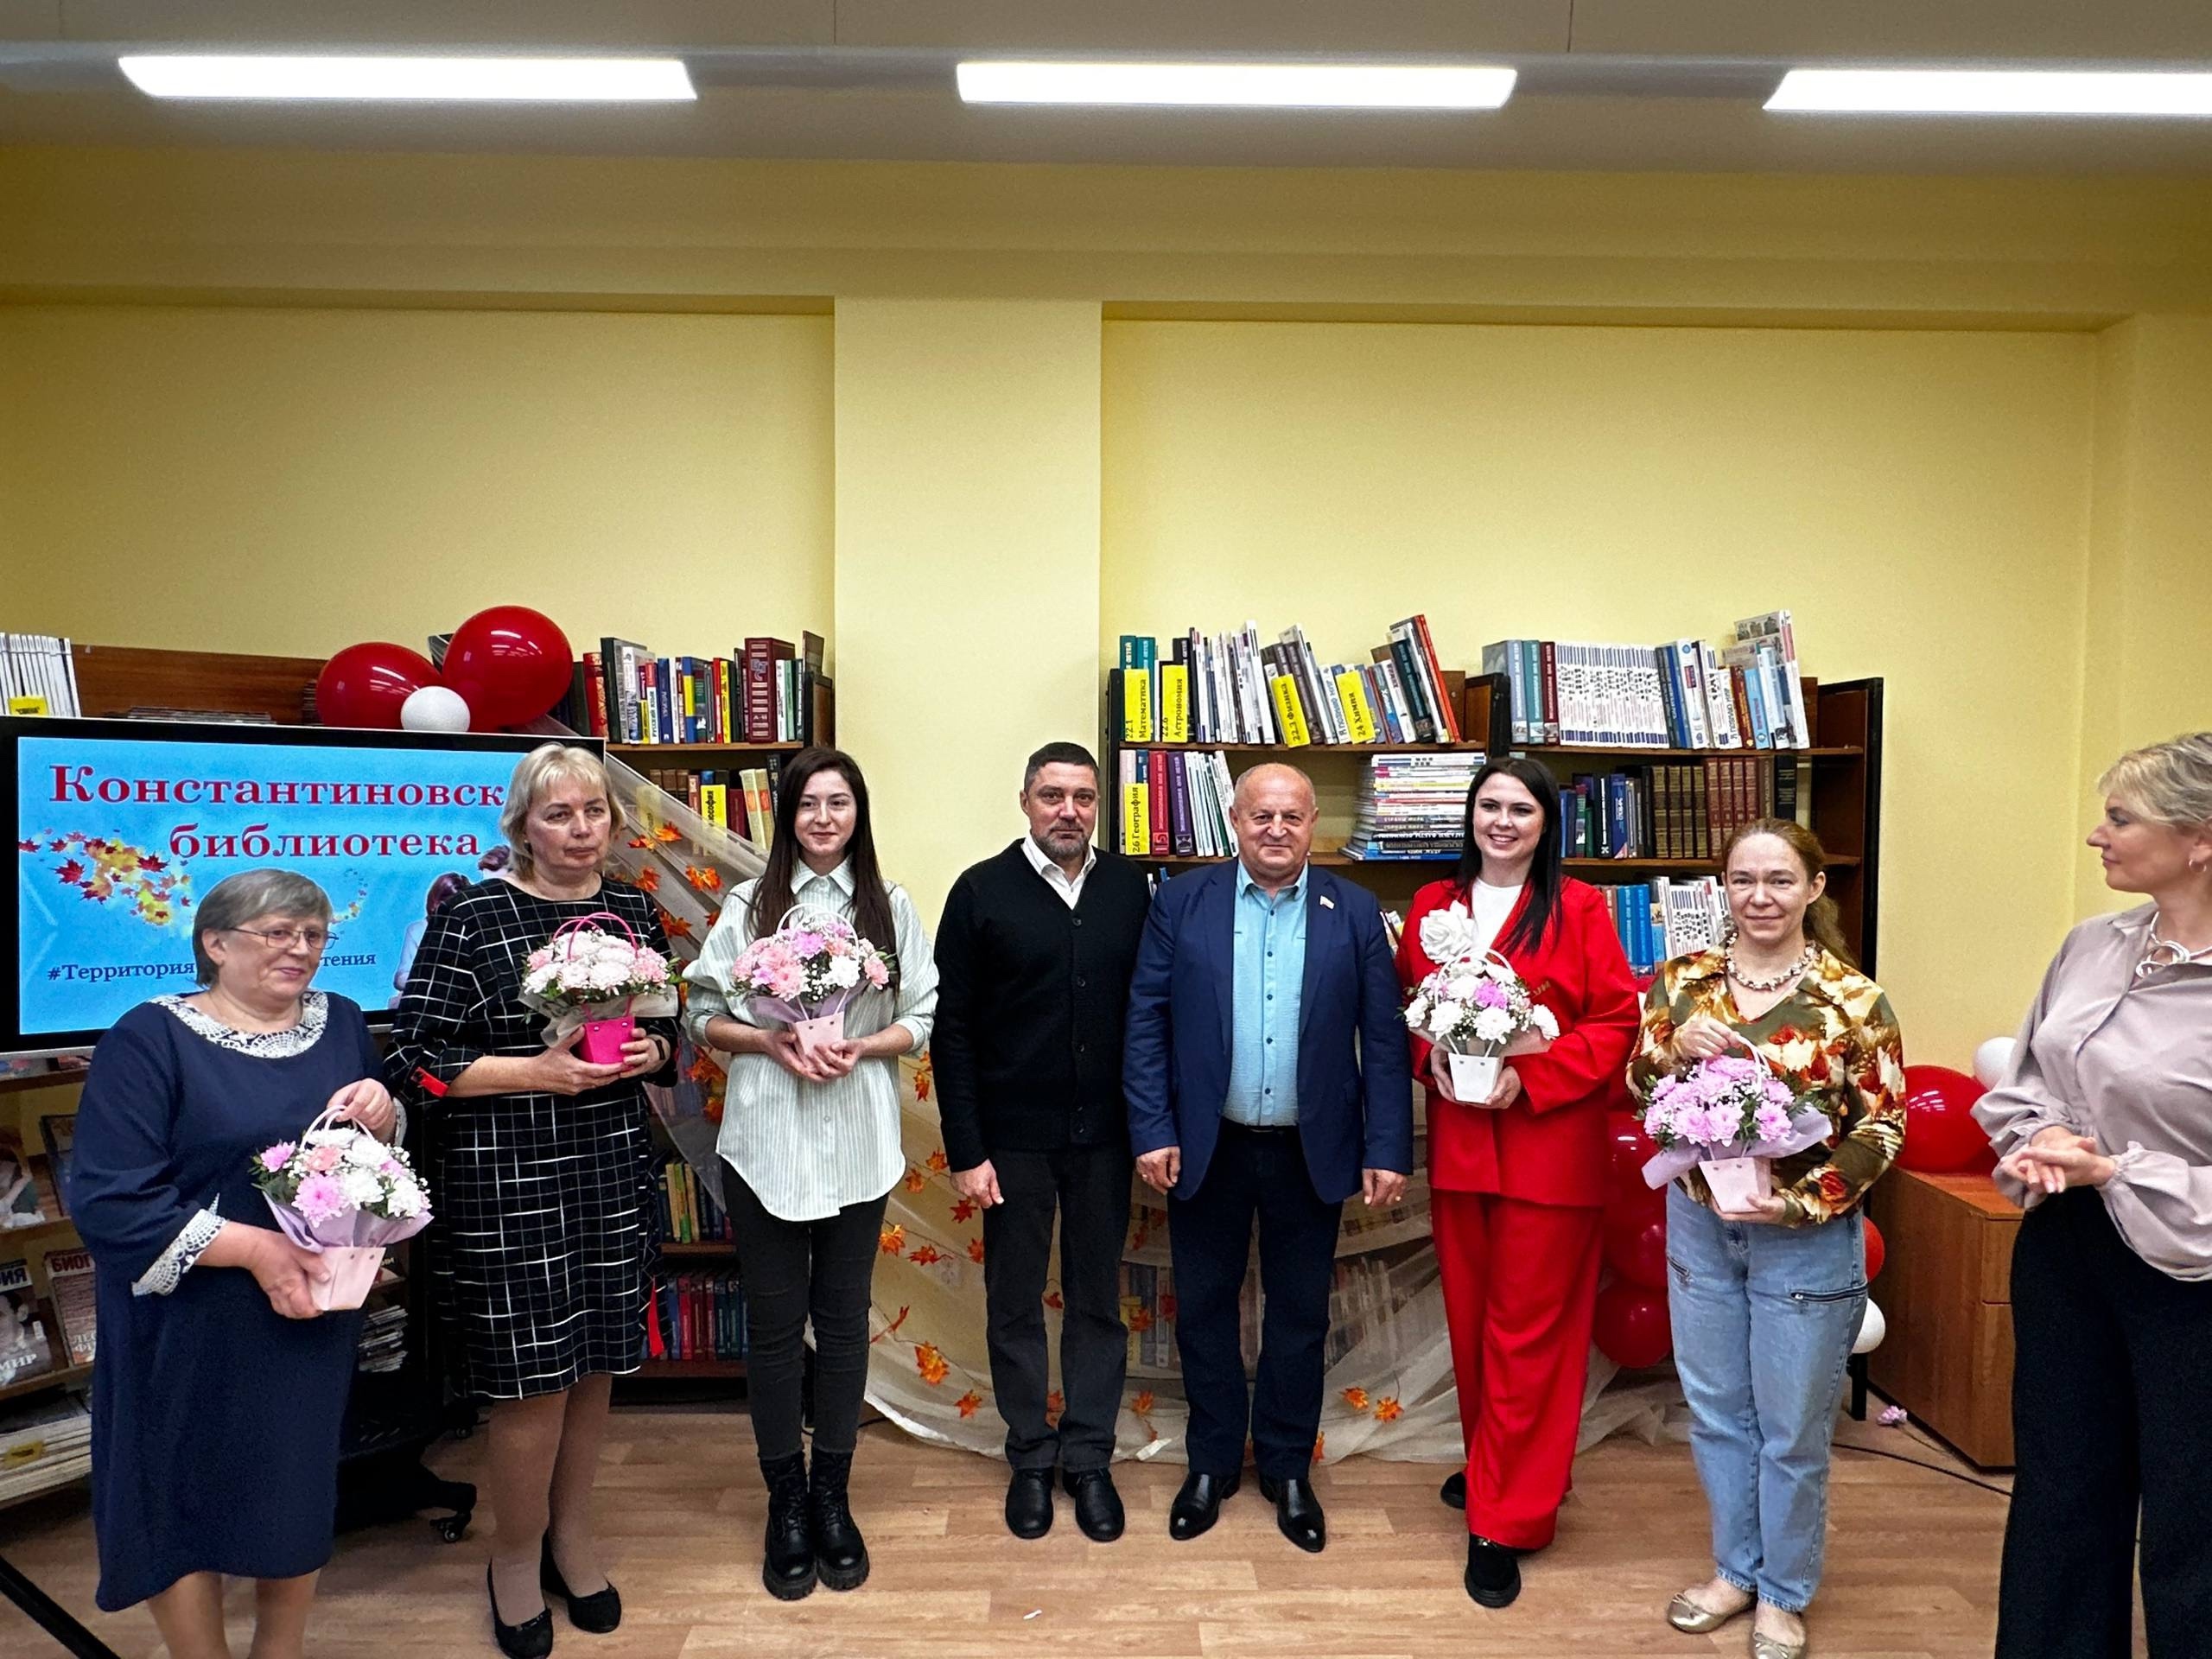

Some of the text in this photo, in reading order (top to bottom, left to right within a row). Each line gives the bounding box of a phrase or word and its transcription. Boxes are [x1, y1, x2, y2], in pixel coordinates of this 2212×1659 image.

[1173, 677, 1184, 738] Астрономия
[1282, 683, 1300, 741] 22.3 Физика
[1350, 692, 1366, 737] 24 Химия
[1125, 719, 1134, 740] 22.1
[49, 765, 505, 806] Константиновск
[169, 823, 481, 858] библиотека
[1130, 786, 1141, 853] 26 География
[48, 953, 377, 982] #Территория тения
